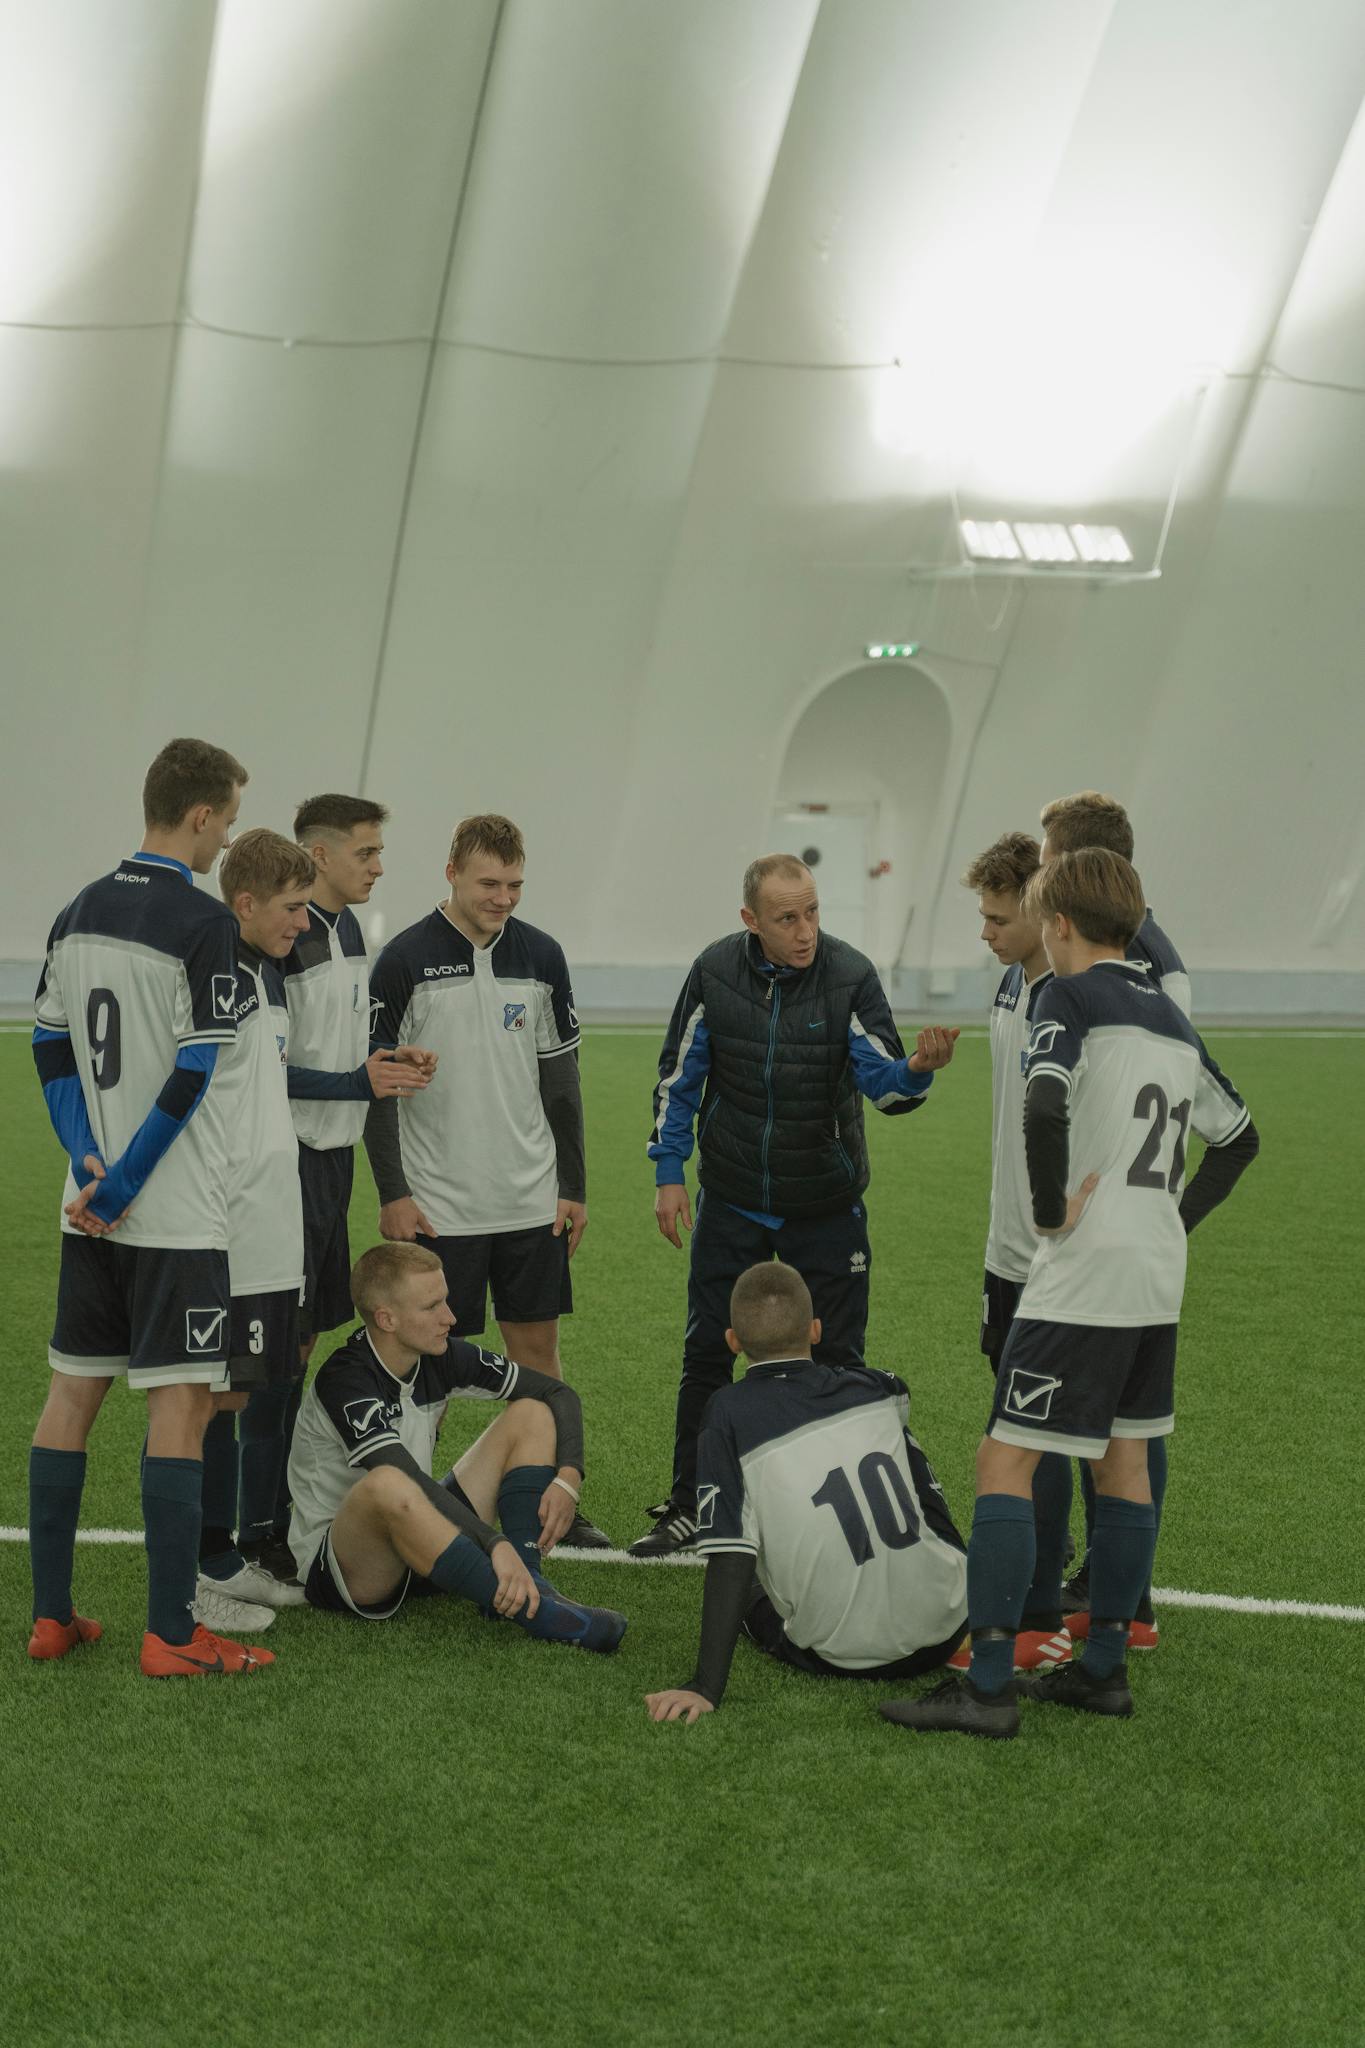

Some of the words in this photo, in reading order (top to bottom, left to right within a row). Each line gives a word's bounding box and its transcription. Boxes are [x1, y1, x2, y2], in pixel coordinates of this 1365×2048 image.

[114, 873, 150, 885] GIVOVA
[87, 987, 121, 1091] 9
[1127, 1082, 1192, 1194] 21
[249, 1319, 264, 1355] 3
[811, 1451, 921, 1567] 10
